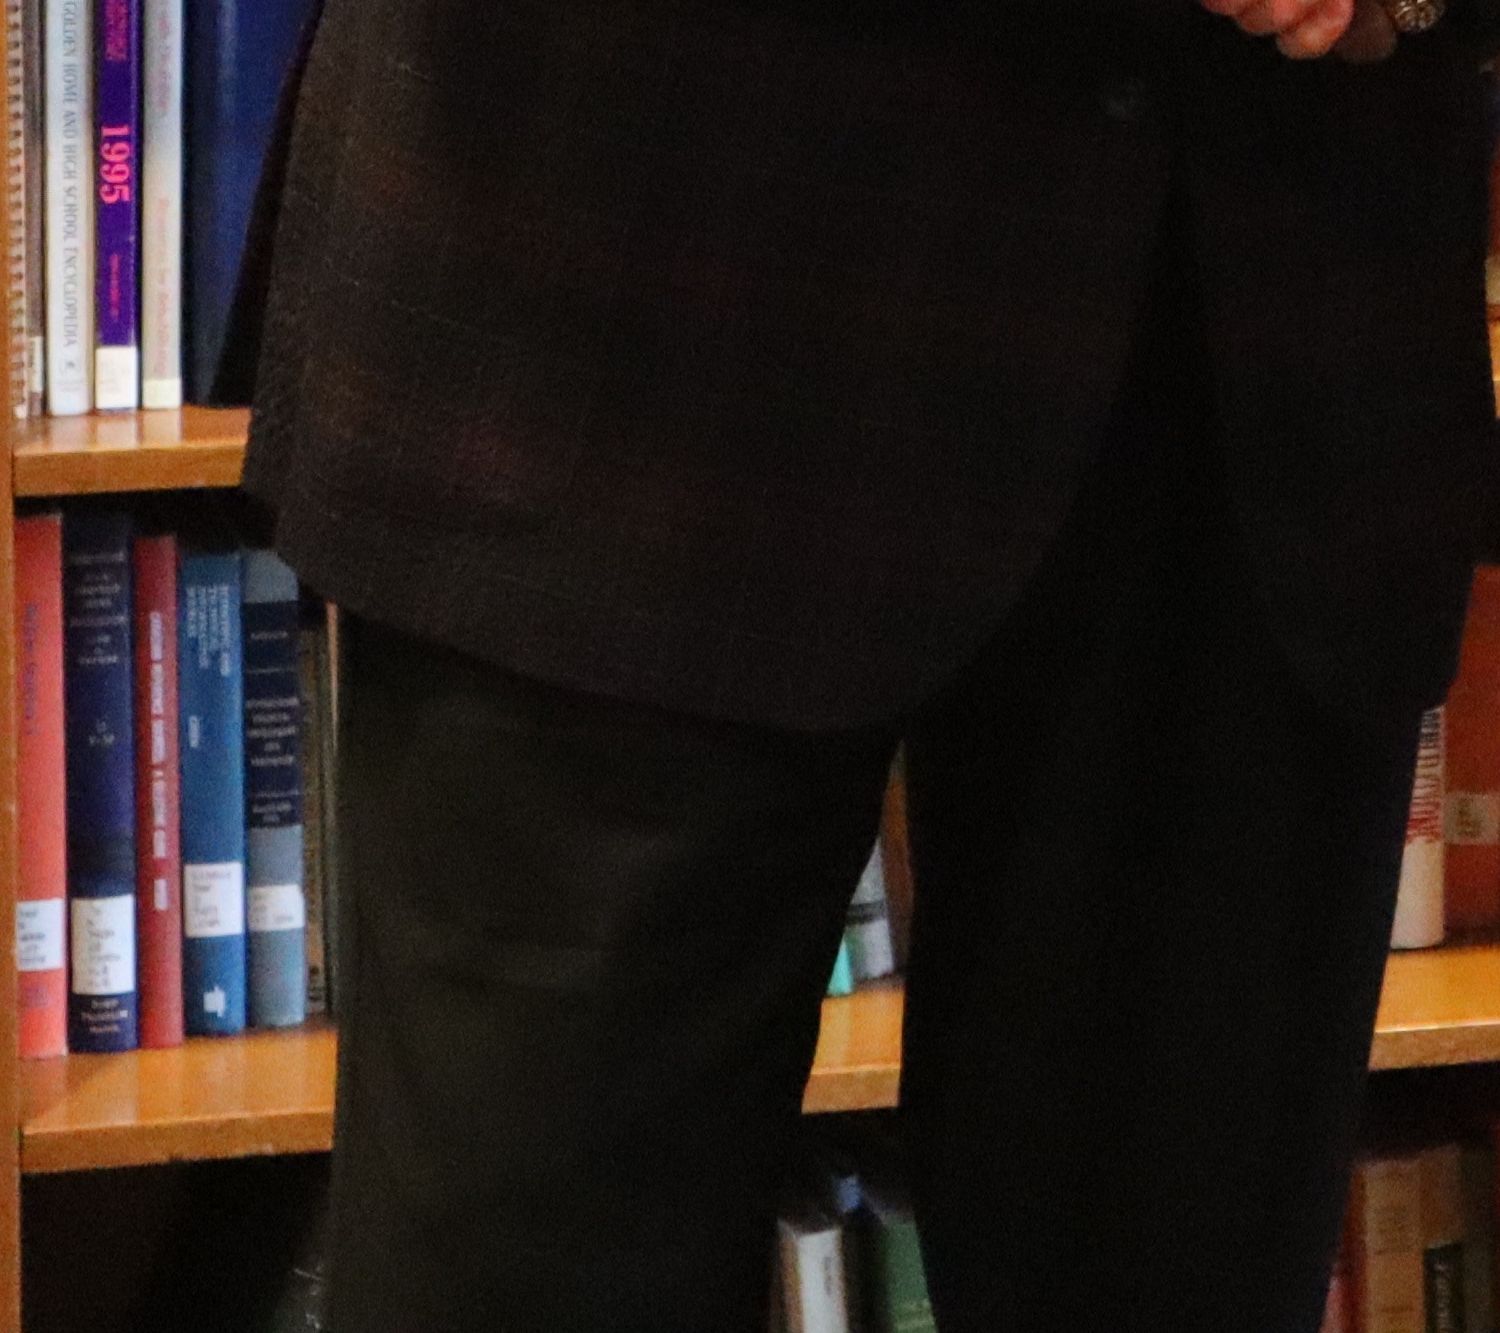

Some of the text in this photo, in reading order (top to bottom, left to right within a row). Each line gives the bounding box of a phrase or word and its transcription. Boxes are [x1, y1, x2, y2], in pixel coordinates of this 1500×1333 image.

[62, 1, 81, 59] GOLDEN
[62, 62, 81, 106] HOME
[62, 108, 81, 139] AND
[62, 143, 81, 181] HIGH
[99, 123, 132, 206] 1995
[62, 184, 81, 241] SCHOOL
[61, 246, 81, 348] ENCYCLOPEDIA
